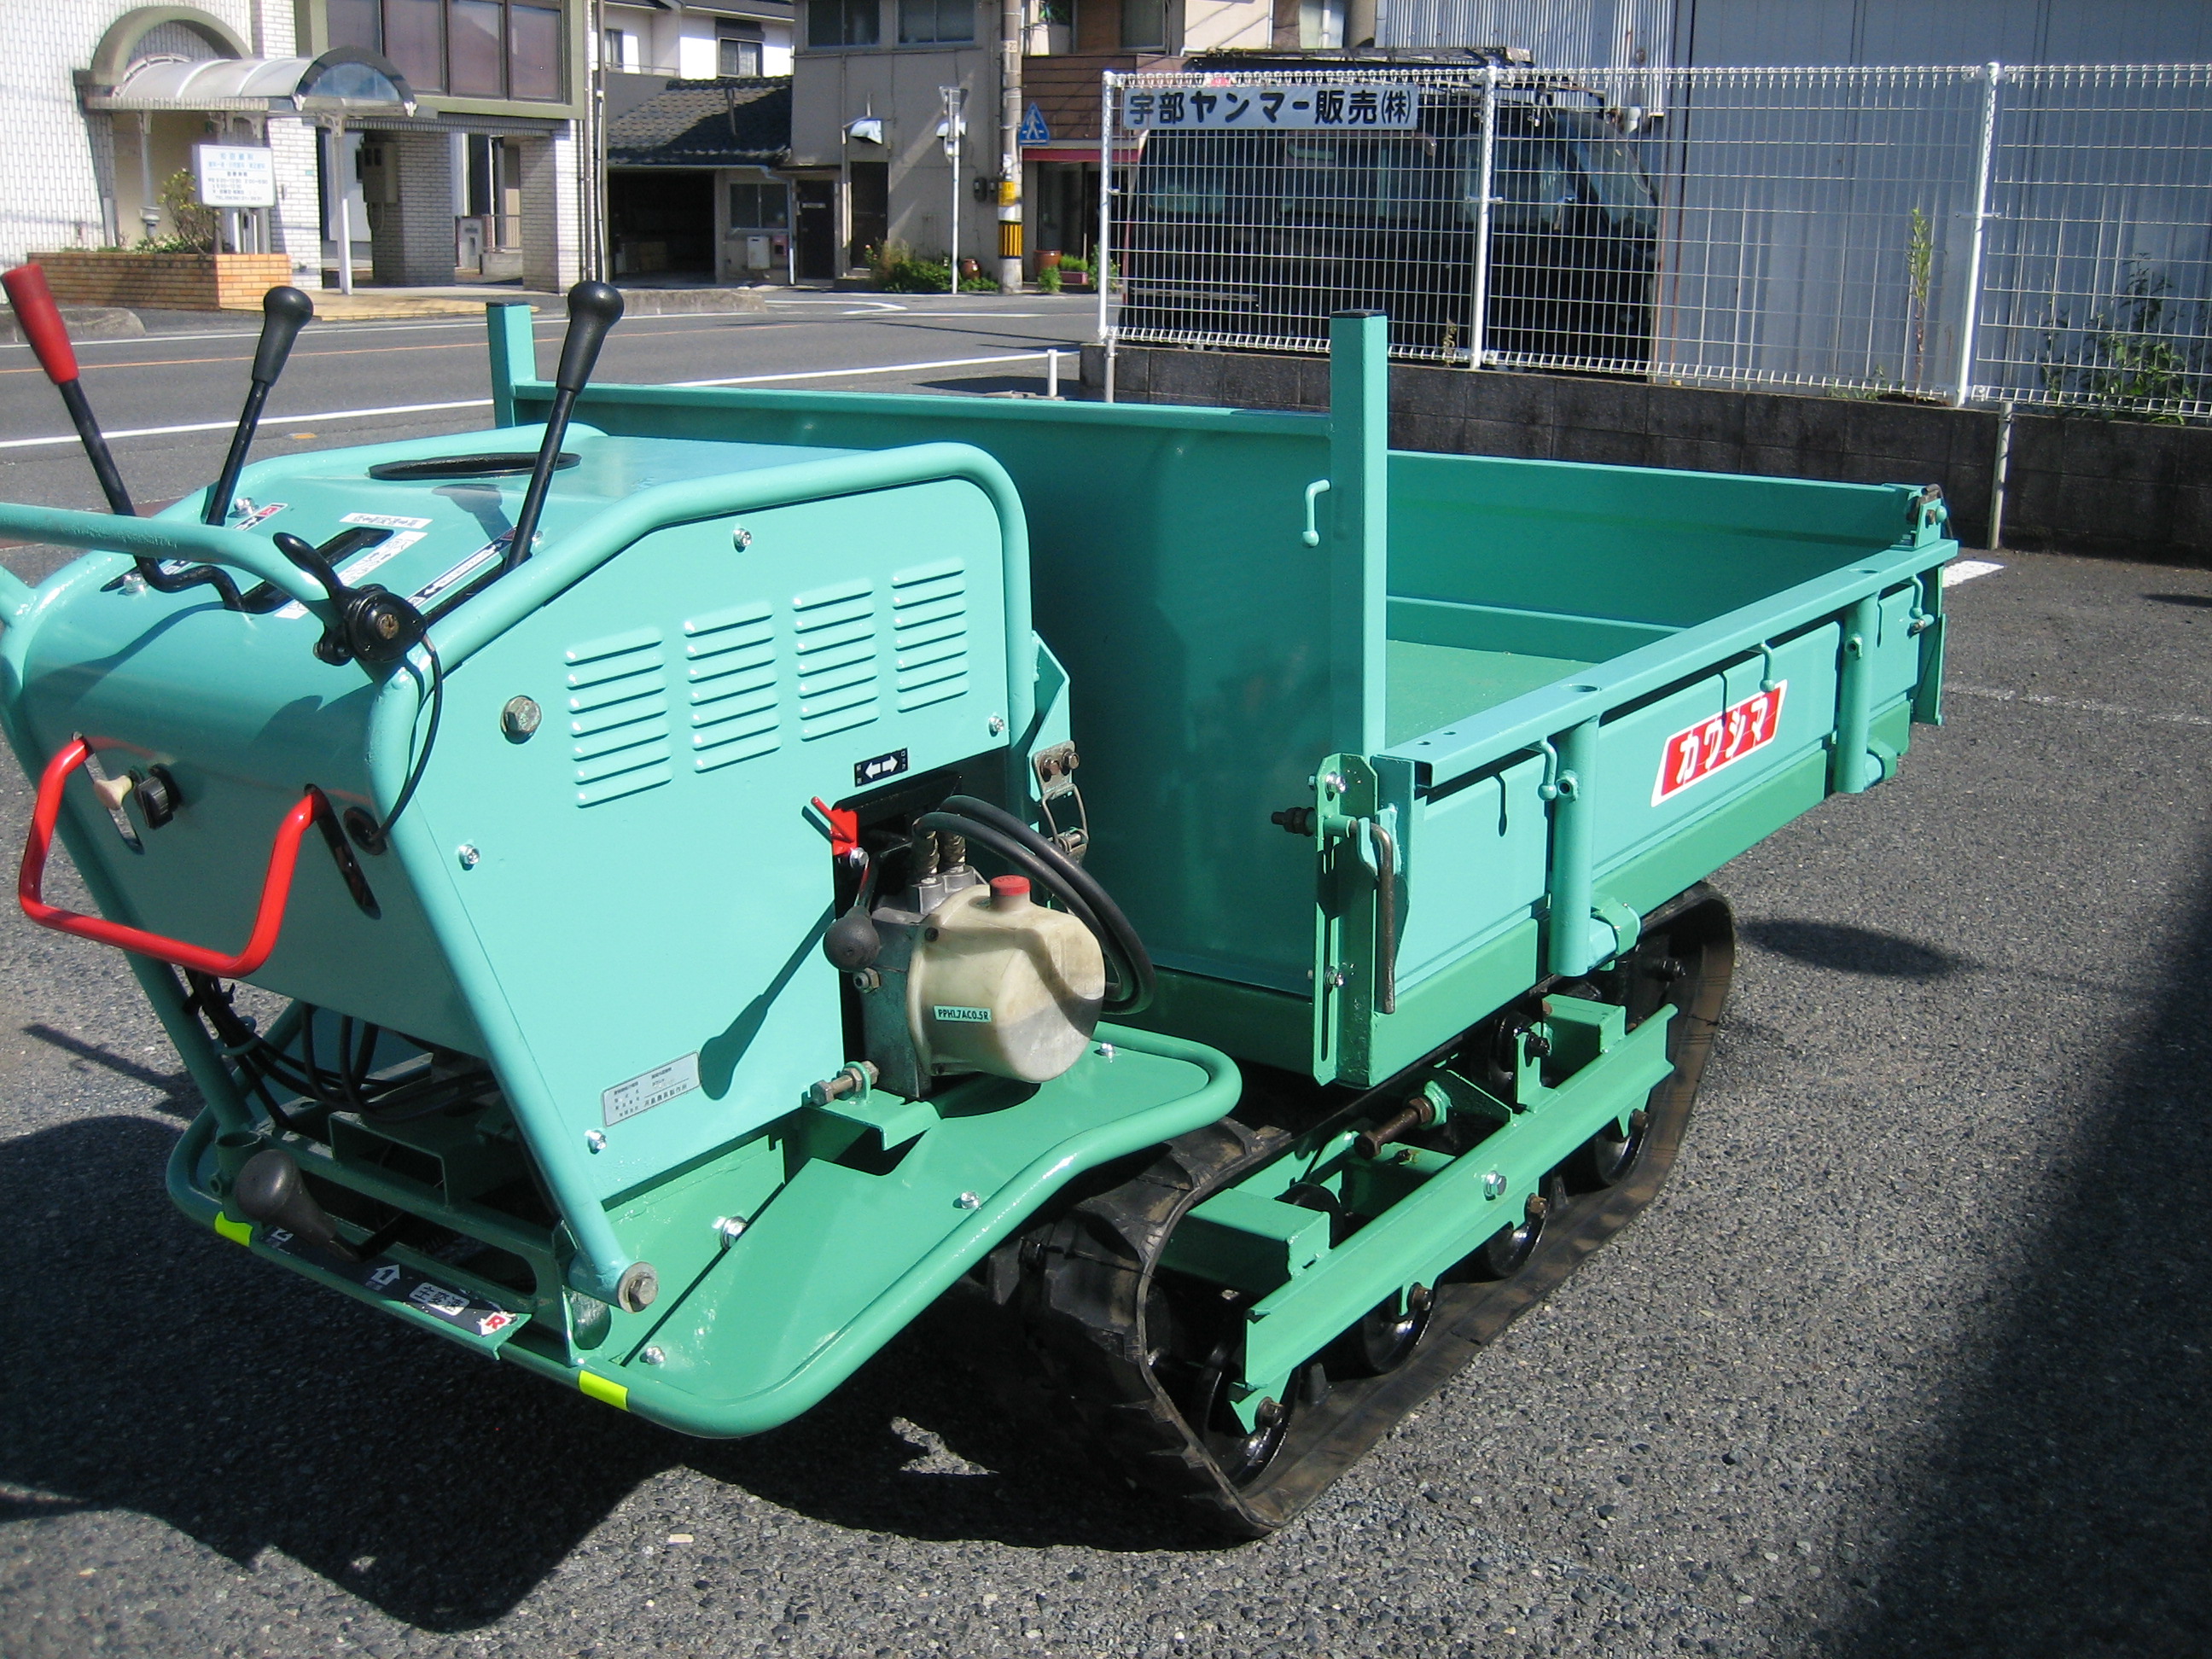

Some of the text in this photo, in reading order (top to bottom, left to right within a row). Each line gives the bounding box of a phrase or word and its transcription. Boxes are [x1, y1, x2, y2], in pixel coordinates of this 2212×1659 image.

[1676, 697, 1768, 784] カワシマ
[414, 1285, 465, 1313] 主変速
[485, 1314, 506, 1330] R
